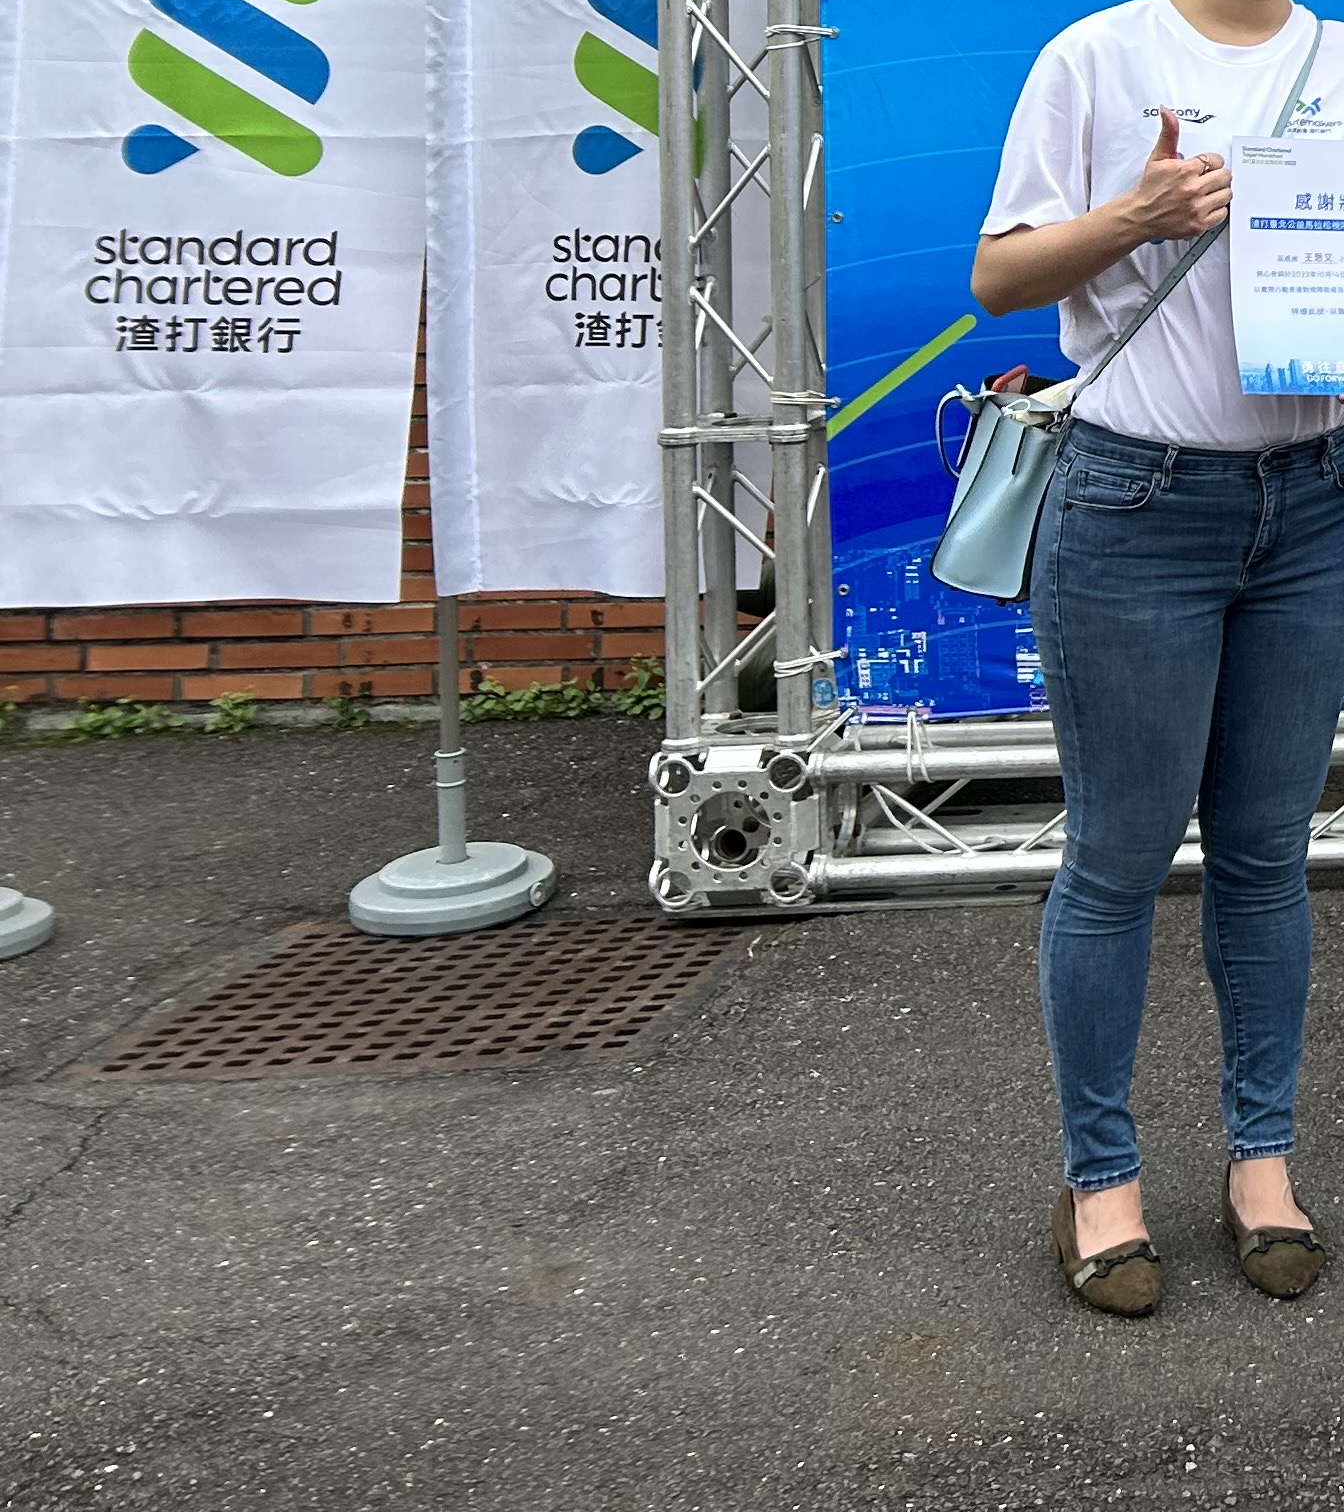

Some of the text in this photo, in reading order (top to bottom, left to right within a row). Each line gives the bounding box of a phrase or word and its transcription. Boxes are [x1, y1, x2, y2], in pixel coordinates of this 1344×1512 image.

[1143, 108, 1201, 118] saony
[93, 228, 338, 266] standard
[552, 227, 661, 263] stan
[84, 268, 342, 306] chartered
[115, 315, 301, 354] 渣打銀行
[575, 310, 662, 348] 渣打
